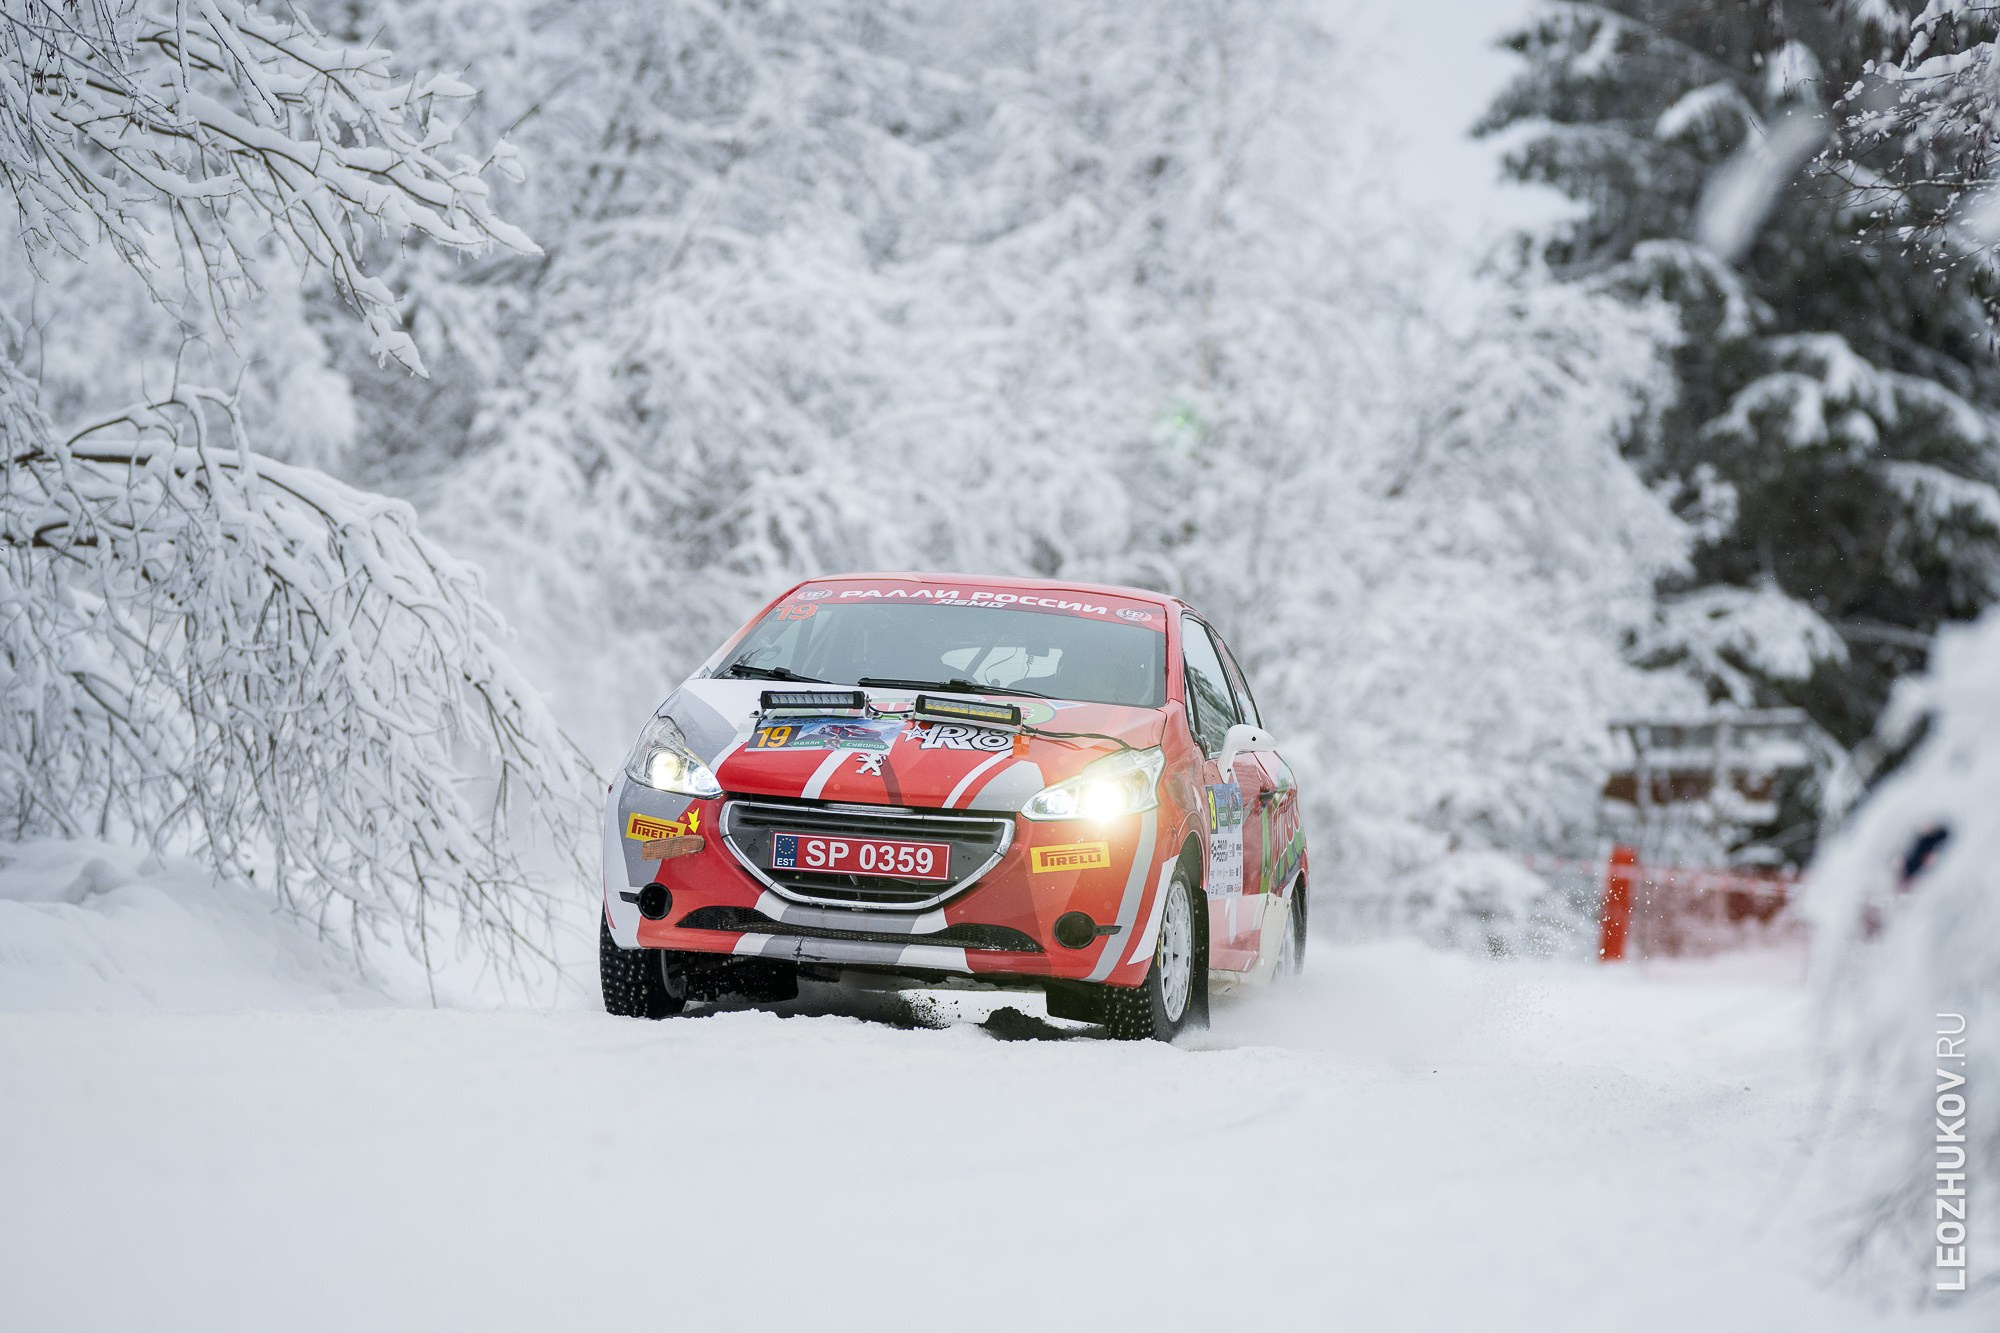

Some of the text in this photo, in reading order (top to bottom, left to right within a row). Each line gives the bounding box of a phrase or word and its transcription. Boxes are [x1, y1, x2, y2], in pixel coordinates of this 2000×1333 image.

[776, 603, 819, 621] 19
[839, 589, 960, 599] РАЛЛИ
[970, 591, 1108, 616] РОССИИ
[756, 726, 793, 748] 19
[776, 857, 795, 867] EST
[805, 840, 934, 874] SP 0359
[1040, 847, 1102, 867] PIRELLI
